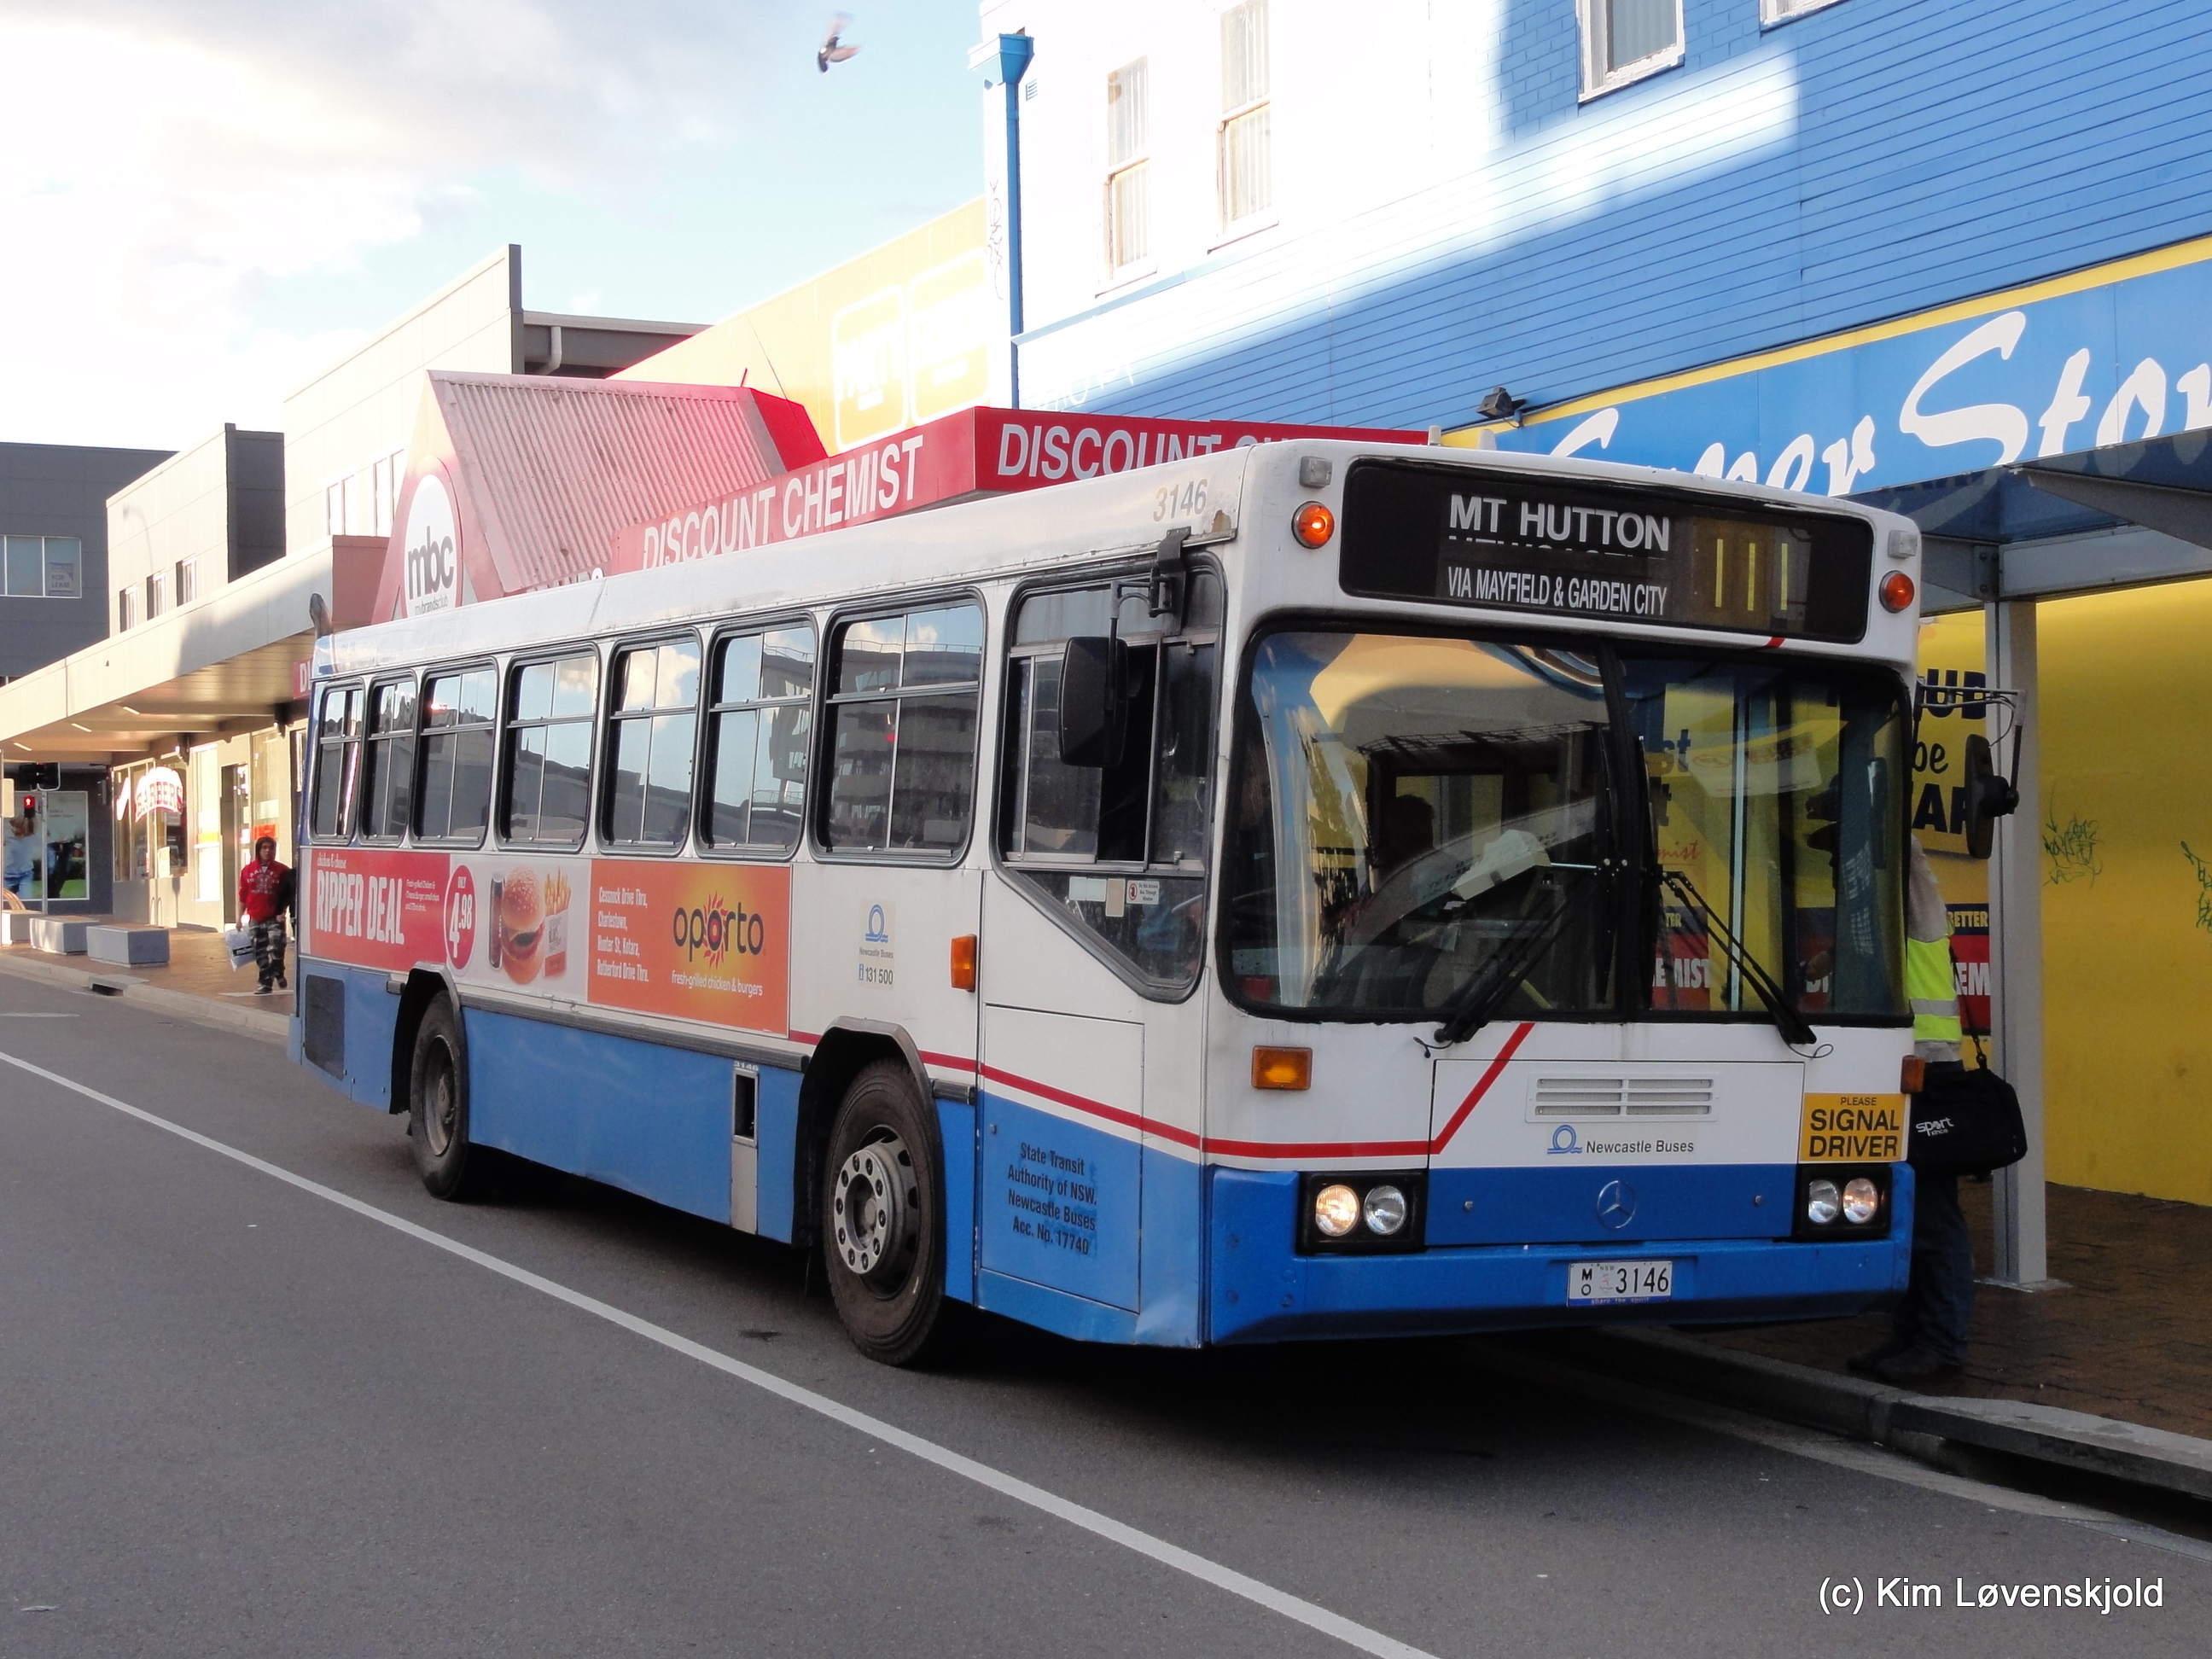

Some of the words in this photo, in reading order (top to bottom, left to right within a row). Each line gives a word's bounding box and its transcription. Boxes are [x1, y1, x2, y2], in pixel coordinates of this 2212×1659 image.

[643, 486, 776, 571] DISCOUNT
[783, 434, 923, 538] CHEMIST
[1152, 478, 1209, 523] 3146
[1450, 494, 1507, 533] MT
[1520, 501, 1670, 552] HUTTON
[408, 525, 454, 601] mbc
[1448, 567, 1472, 598] VIA
[1476, 568, 1550, 605] MAYFIELD
[1553, 578, 1563, 607] &
[1568, 578, 1630, 613] GARDEN
[1634, 584, 1668, 617] CITY
[316, 870, 364, 937] RIPPER
[367, 876, 405, 946] DEAL
[621, 888, 634, 905] Drive
[450, 893, 473, 958] 4.98
[672, 901, 765, 962] oporto
[859, 946, 880, 958] Newcastle
[881, 949, 894, 959] Buses
[622, 961, 635, 981] Drive
[672, 969, 707, 990] fresh-grilled
[707, 975, 731, 992] chicken
[731, 979, 737, 992] &
[737, 979, 763, 998] burgers
[865, 967, 877, 982] 131
[878, 969, 894, 985] 500
[734, 1061, 759, 1072] 3146
[1840, 1097, 1877, 1106] PLEASE
[1810, 1109, 1900, 1132] SIGNAL
[1020, 1142, 1046, 1165] State
[1049, 1150, 1085, 1176] Transit
[1586, 1140, 1651, 1154] Newcastle
[1656, 1139, 1695, 1153] Buses
[1809, 1135, 1898, 1157] DRIVER
[1007, 1164, 1054, 1196] Authority
[1057, 1179, 1068, 1196] of
[1070, 1182, 1097, 1206] NSW.
[1009, 1189, 1061, 1220] Newcastle
[1063, 1206, 1096, 1231] Buses
[1013, 1215, 1034, 1237] Acc.
[1037, 1223, 1054, 1243] No.
[1057, 1230, 1090, 1255] 17740
[1615, 1267, 1669, 1294] 3146
